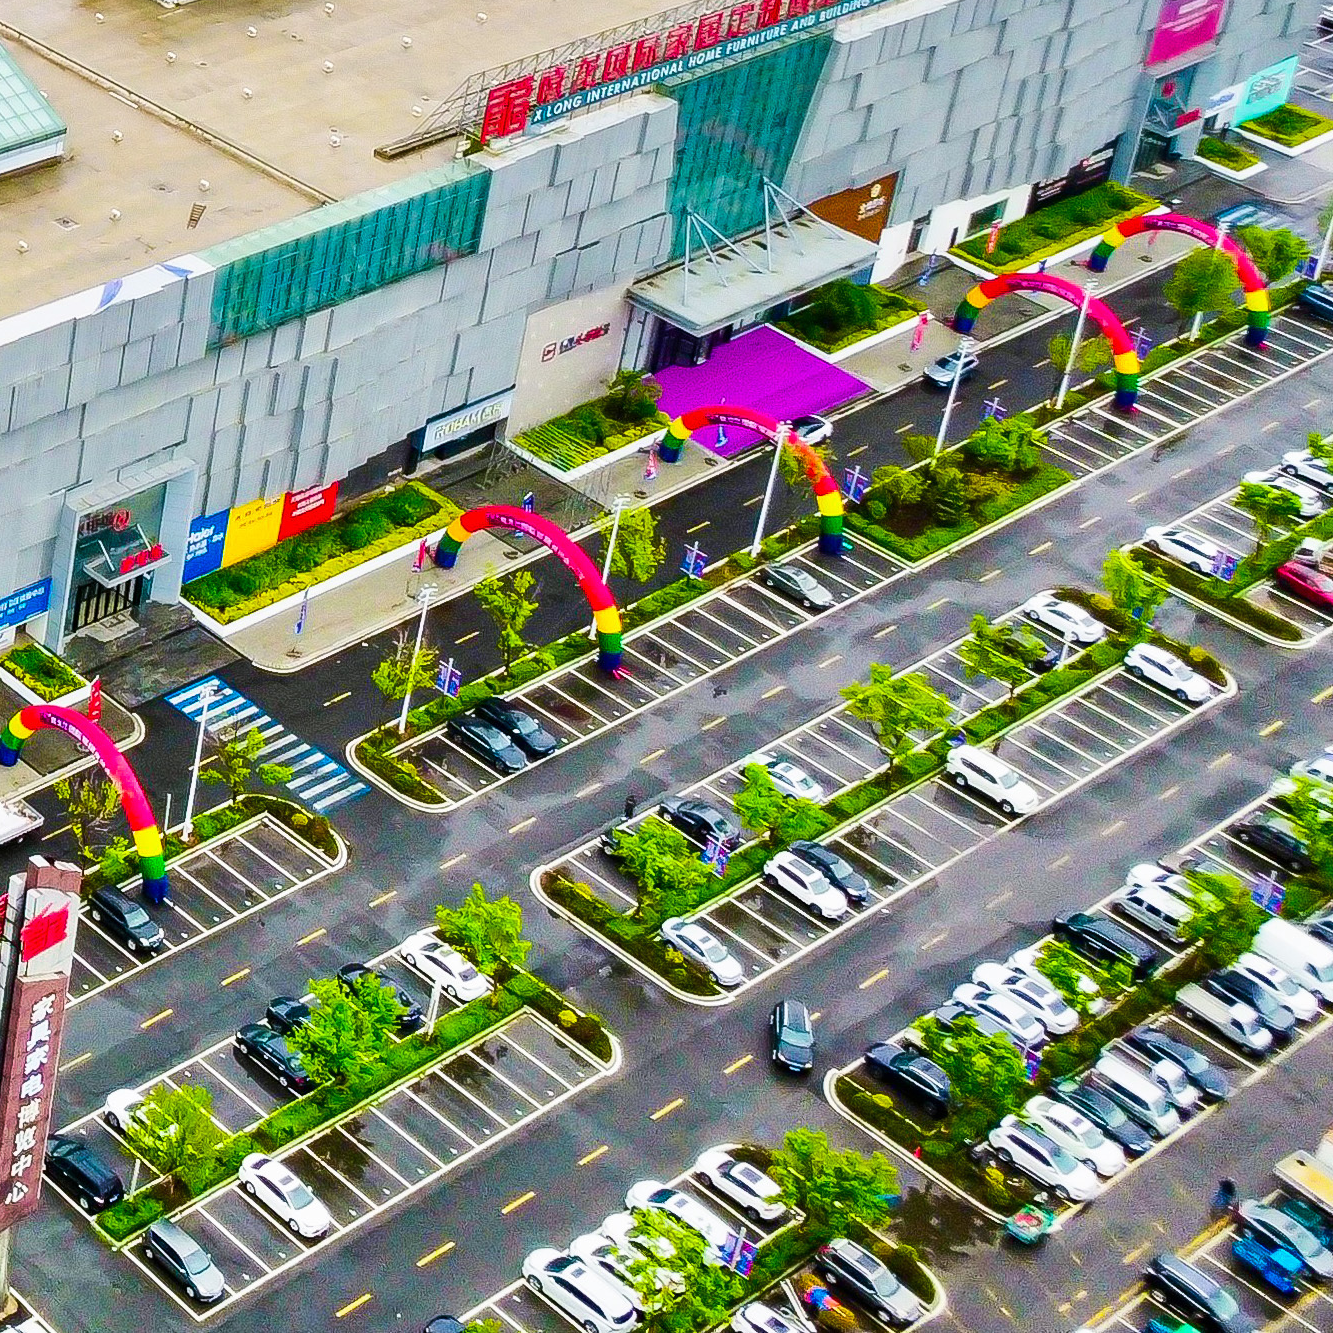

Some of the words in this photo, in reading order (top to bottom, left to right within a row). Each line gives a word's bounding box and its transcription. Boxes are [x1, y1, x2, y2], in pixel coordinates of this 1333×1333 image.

[586, 62, 685, 104] INTERNATIONAL
[687, 46, 722, 68] HOME
[725, 24, 788, 55] FURNITURE
[790, 14, 817, 34] AND
